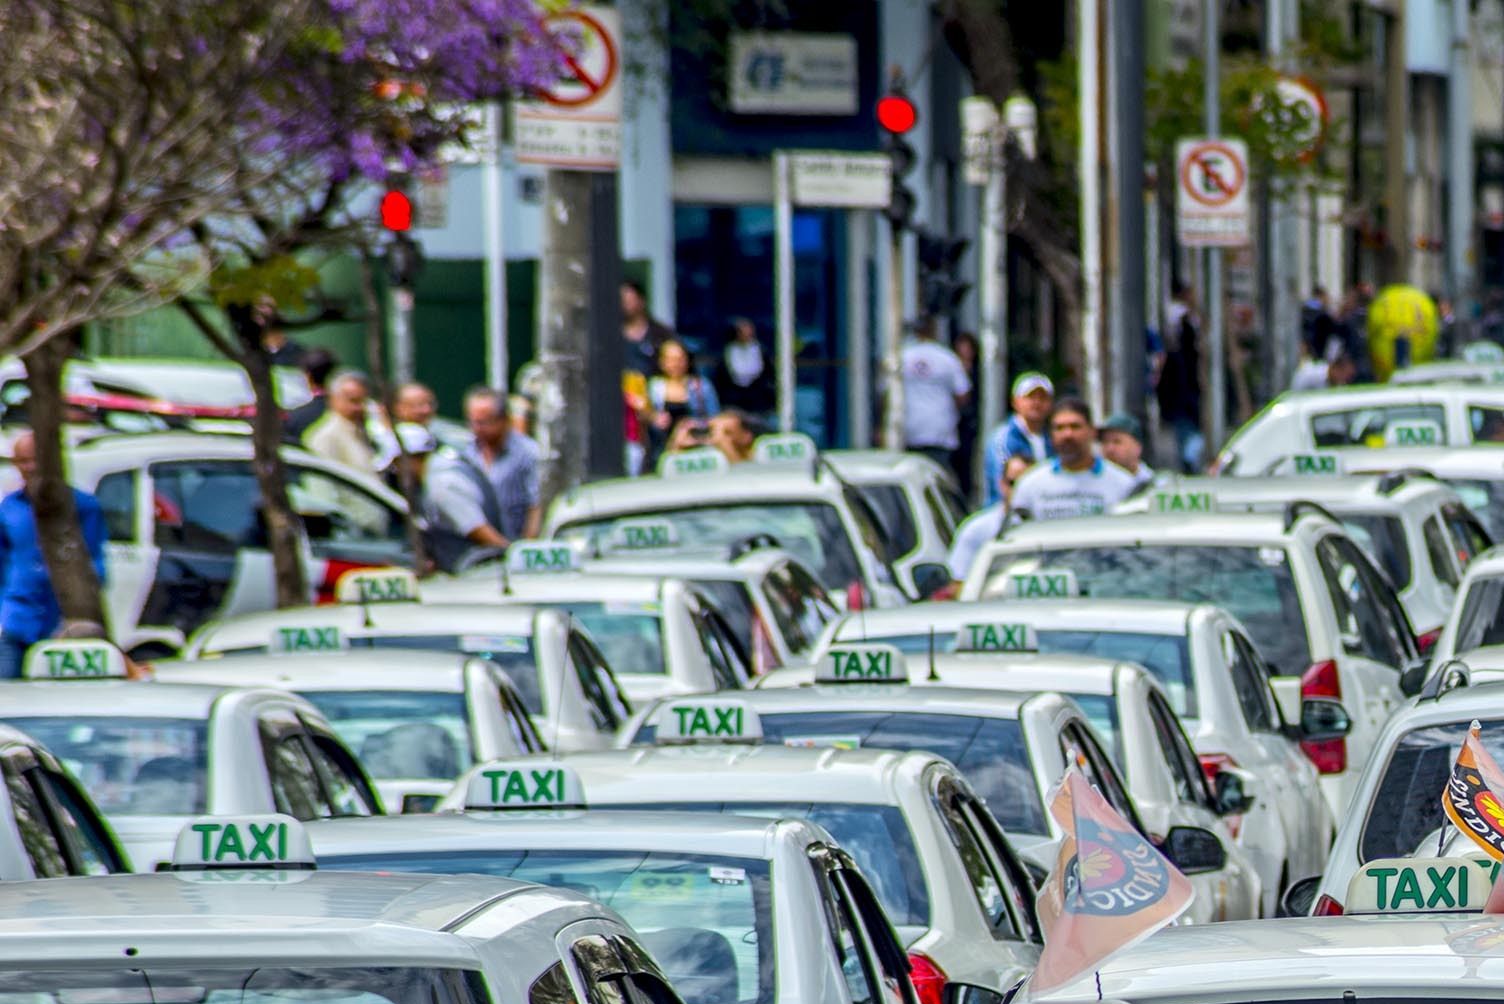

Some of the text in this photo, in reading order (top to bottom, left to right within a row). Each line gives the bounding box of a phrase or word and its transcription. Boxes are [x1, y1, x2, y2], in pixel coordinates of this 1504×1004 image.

[1396, 427, 1437, 445] TAXI
[675, 453, 718, 473] TAXI
[1294, 454, 1337, 475] TAXI
[1155, 493, 1212, 513] TAXI
[624, 526, 669, 546] TAXI
[521, 549, 571, 568] TAXI
[353, 577, 408, 600] TAXI
[1013, 575, 1069, 598] TAXI
[279, 627, 340, 651] TAXI
[966, 624, 1027, 649] TAXI
[44, 649, 109, 677] TAXI
[829, 650, 892, 677] TAXI
[673, 706, 744, 736] TAXI
[482, 769, 566, 803] TAXI
[192, 823, 288, 862] TAXI
[1366, 866, 1469, 911] TAXI
